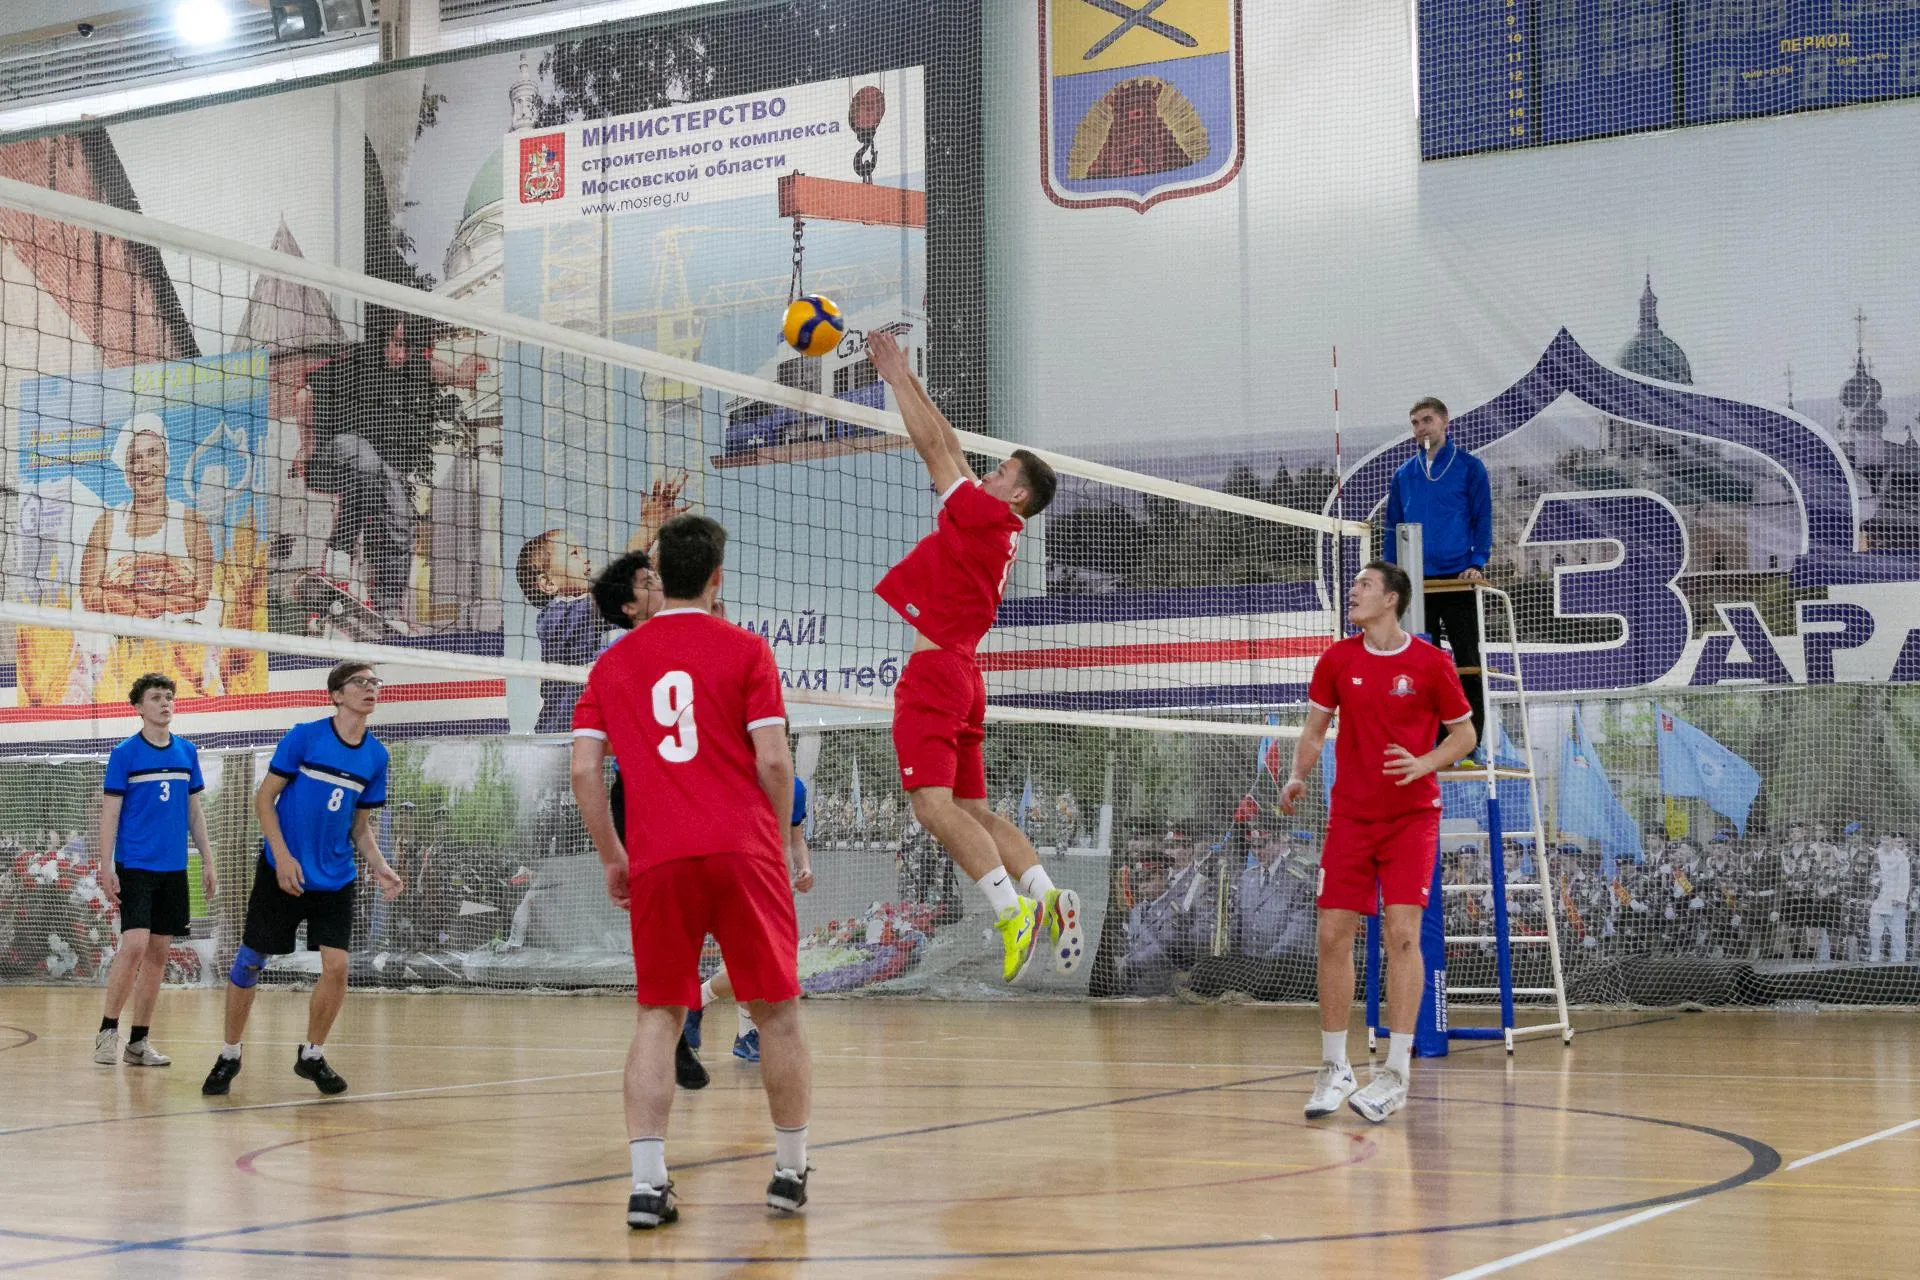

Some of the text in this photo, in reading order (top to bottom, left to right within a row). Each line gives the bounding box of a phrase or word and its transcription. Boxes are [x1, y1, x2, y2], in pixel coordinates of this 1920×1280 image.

[1508, 32, 1522, 43] 10
[1780, 32, 1850, 53] ПЕРИОД
[1508, 52, 1521, 63] 11
[1509, 70, 1523, 81] 12
[1509, 88, 1524, 99] 13
[582, 97, 786, 147] МИНИСТЕРСТВО
[1509, 107, 1525, 118] 14
[1509, 125, 1525, 137] 15
[581, 119, 840, 173] строительного комплекса
[581, 154, 786, 196] Московской области
[581, 191, 690, 216] www.mosreg.ru
[737, 609, 827, 648] МАЙ!
[839, 656, 906, 689] теб
[652, 670, 699, 763] 9
[159, 781, 171, 802] 3
[327, 787, 345, 812] 8
[1434, 969, 1443, 1032] International
